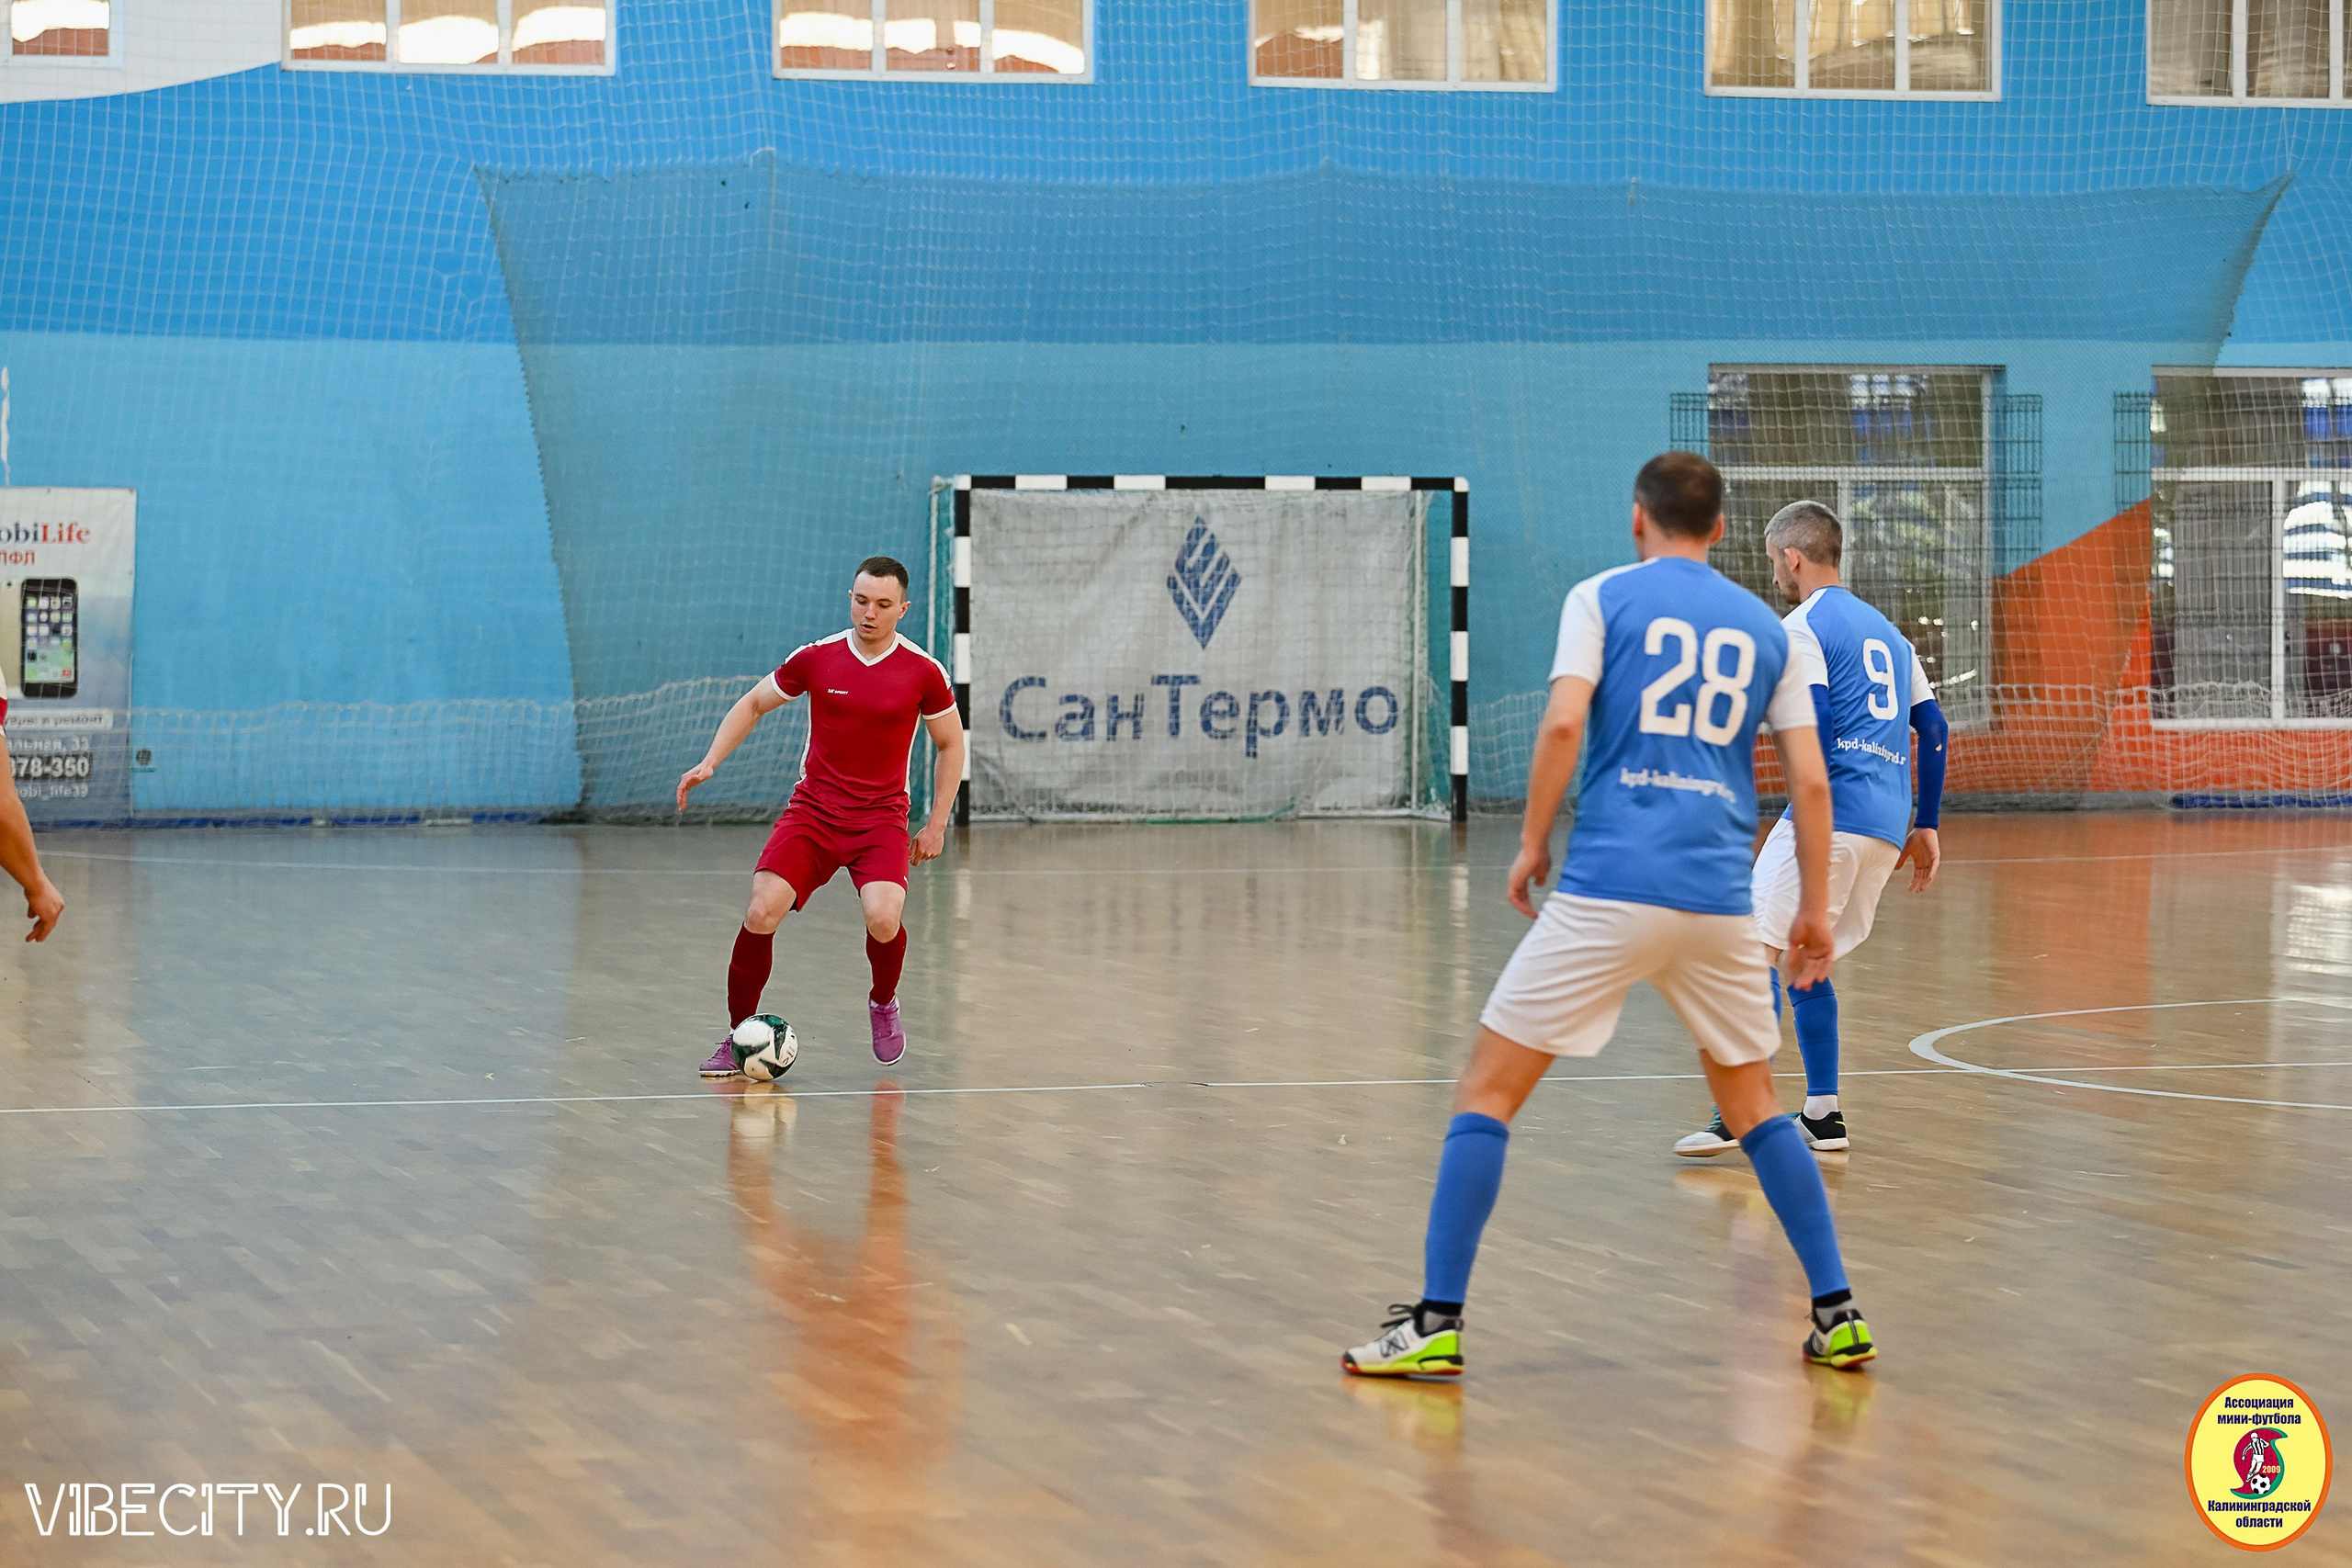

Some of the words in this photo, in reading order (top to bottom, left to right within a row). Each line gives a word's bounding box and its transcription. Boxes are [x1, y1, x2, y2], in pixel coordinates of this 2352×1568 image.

[999, 674, 1399, 759] СанТермо
[1639, 617, 1756, 746] 28
[1862, 638, 1898, 720] 9
[16, 783, 89, 801] obi_life39
